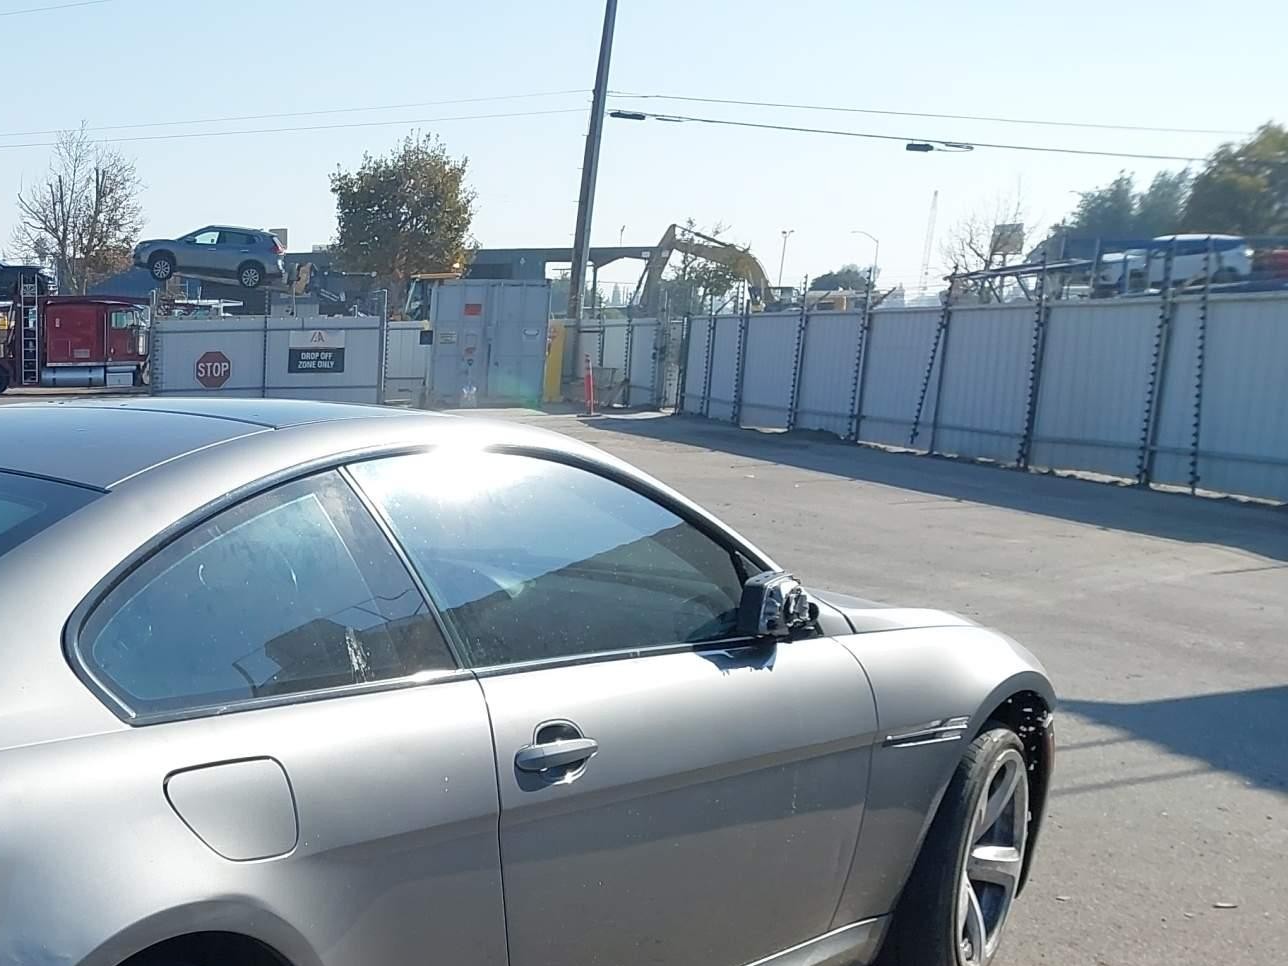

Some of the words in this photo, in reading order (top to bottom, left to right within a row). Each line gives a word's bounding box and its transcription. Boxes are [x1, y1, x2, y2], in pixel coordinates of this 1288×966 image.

[301, 352, 319, 360] DROP
[320, 352, 333, 360] OFF
[298, 360, 317, 369] ZONE
[318, 360, 335, 369] ONLY
[197, 362, 229, 378] STOP
